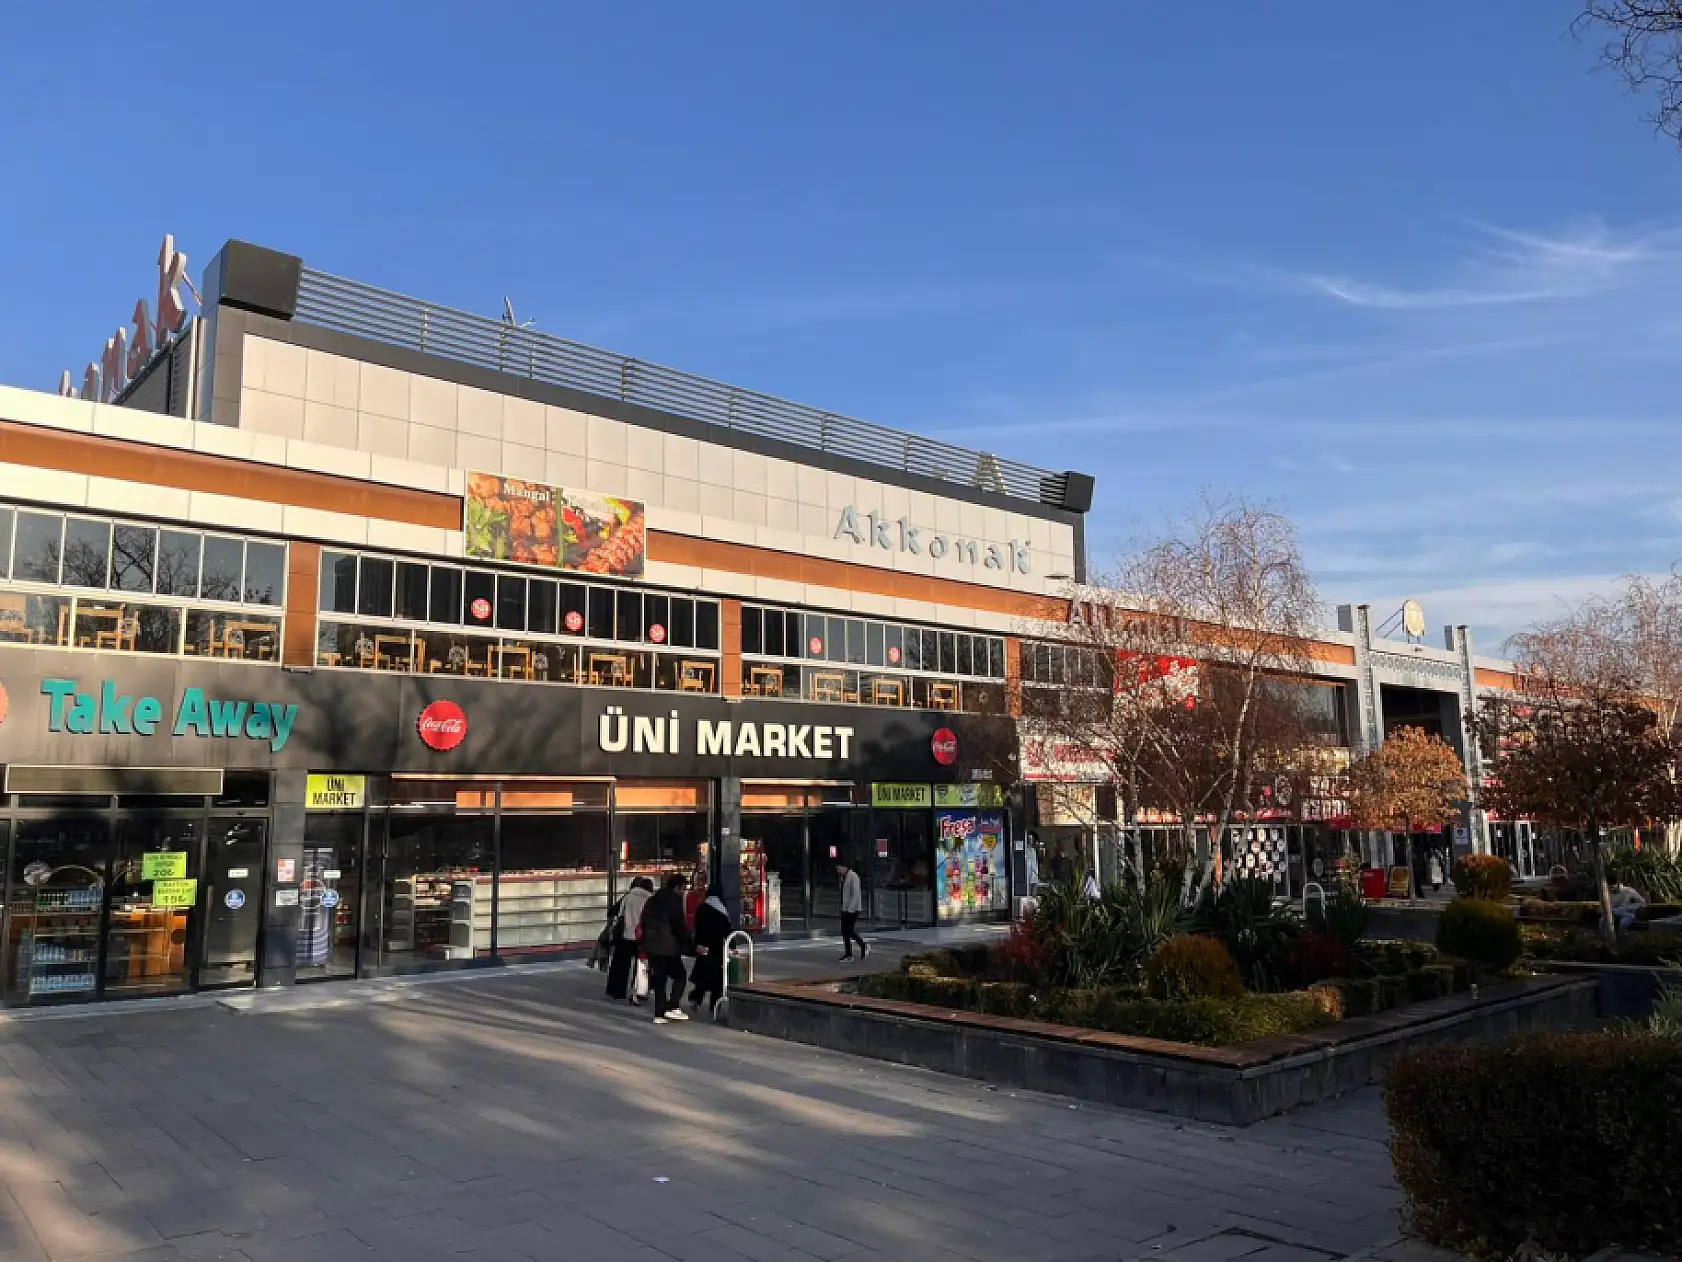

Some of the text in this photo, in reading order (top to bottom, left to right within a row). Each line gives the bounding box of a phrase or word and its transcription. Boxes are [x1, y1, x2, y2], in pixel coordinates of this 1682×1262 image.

[834, 505, 1031, 574] Akkonak
[41, 679, 299, 754] Take Away
[422, 716, 463, 733] Coca-Cola
[599, 706, 855, 759] ÜNİ MARKET
[312, 792, 356, 805] MARKET
